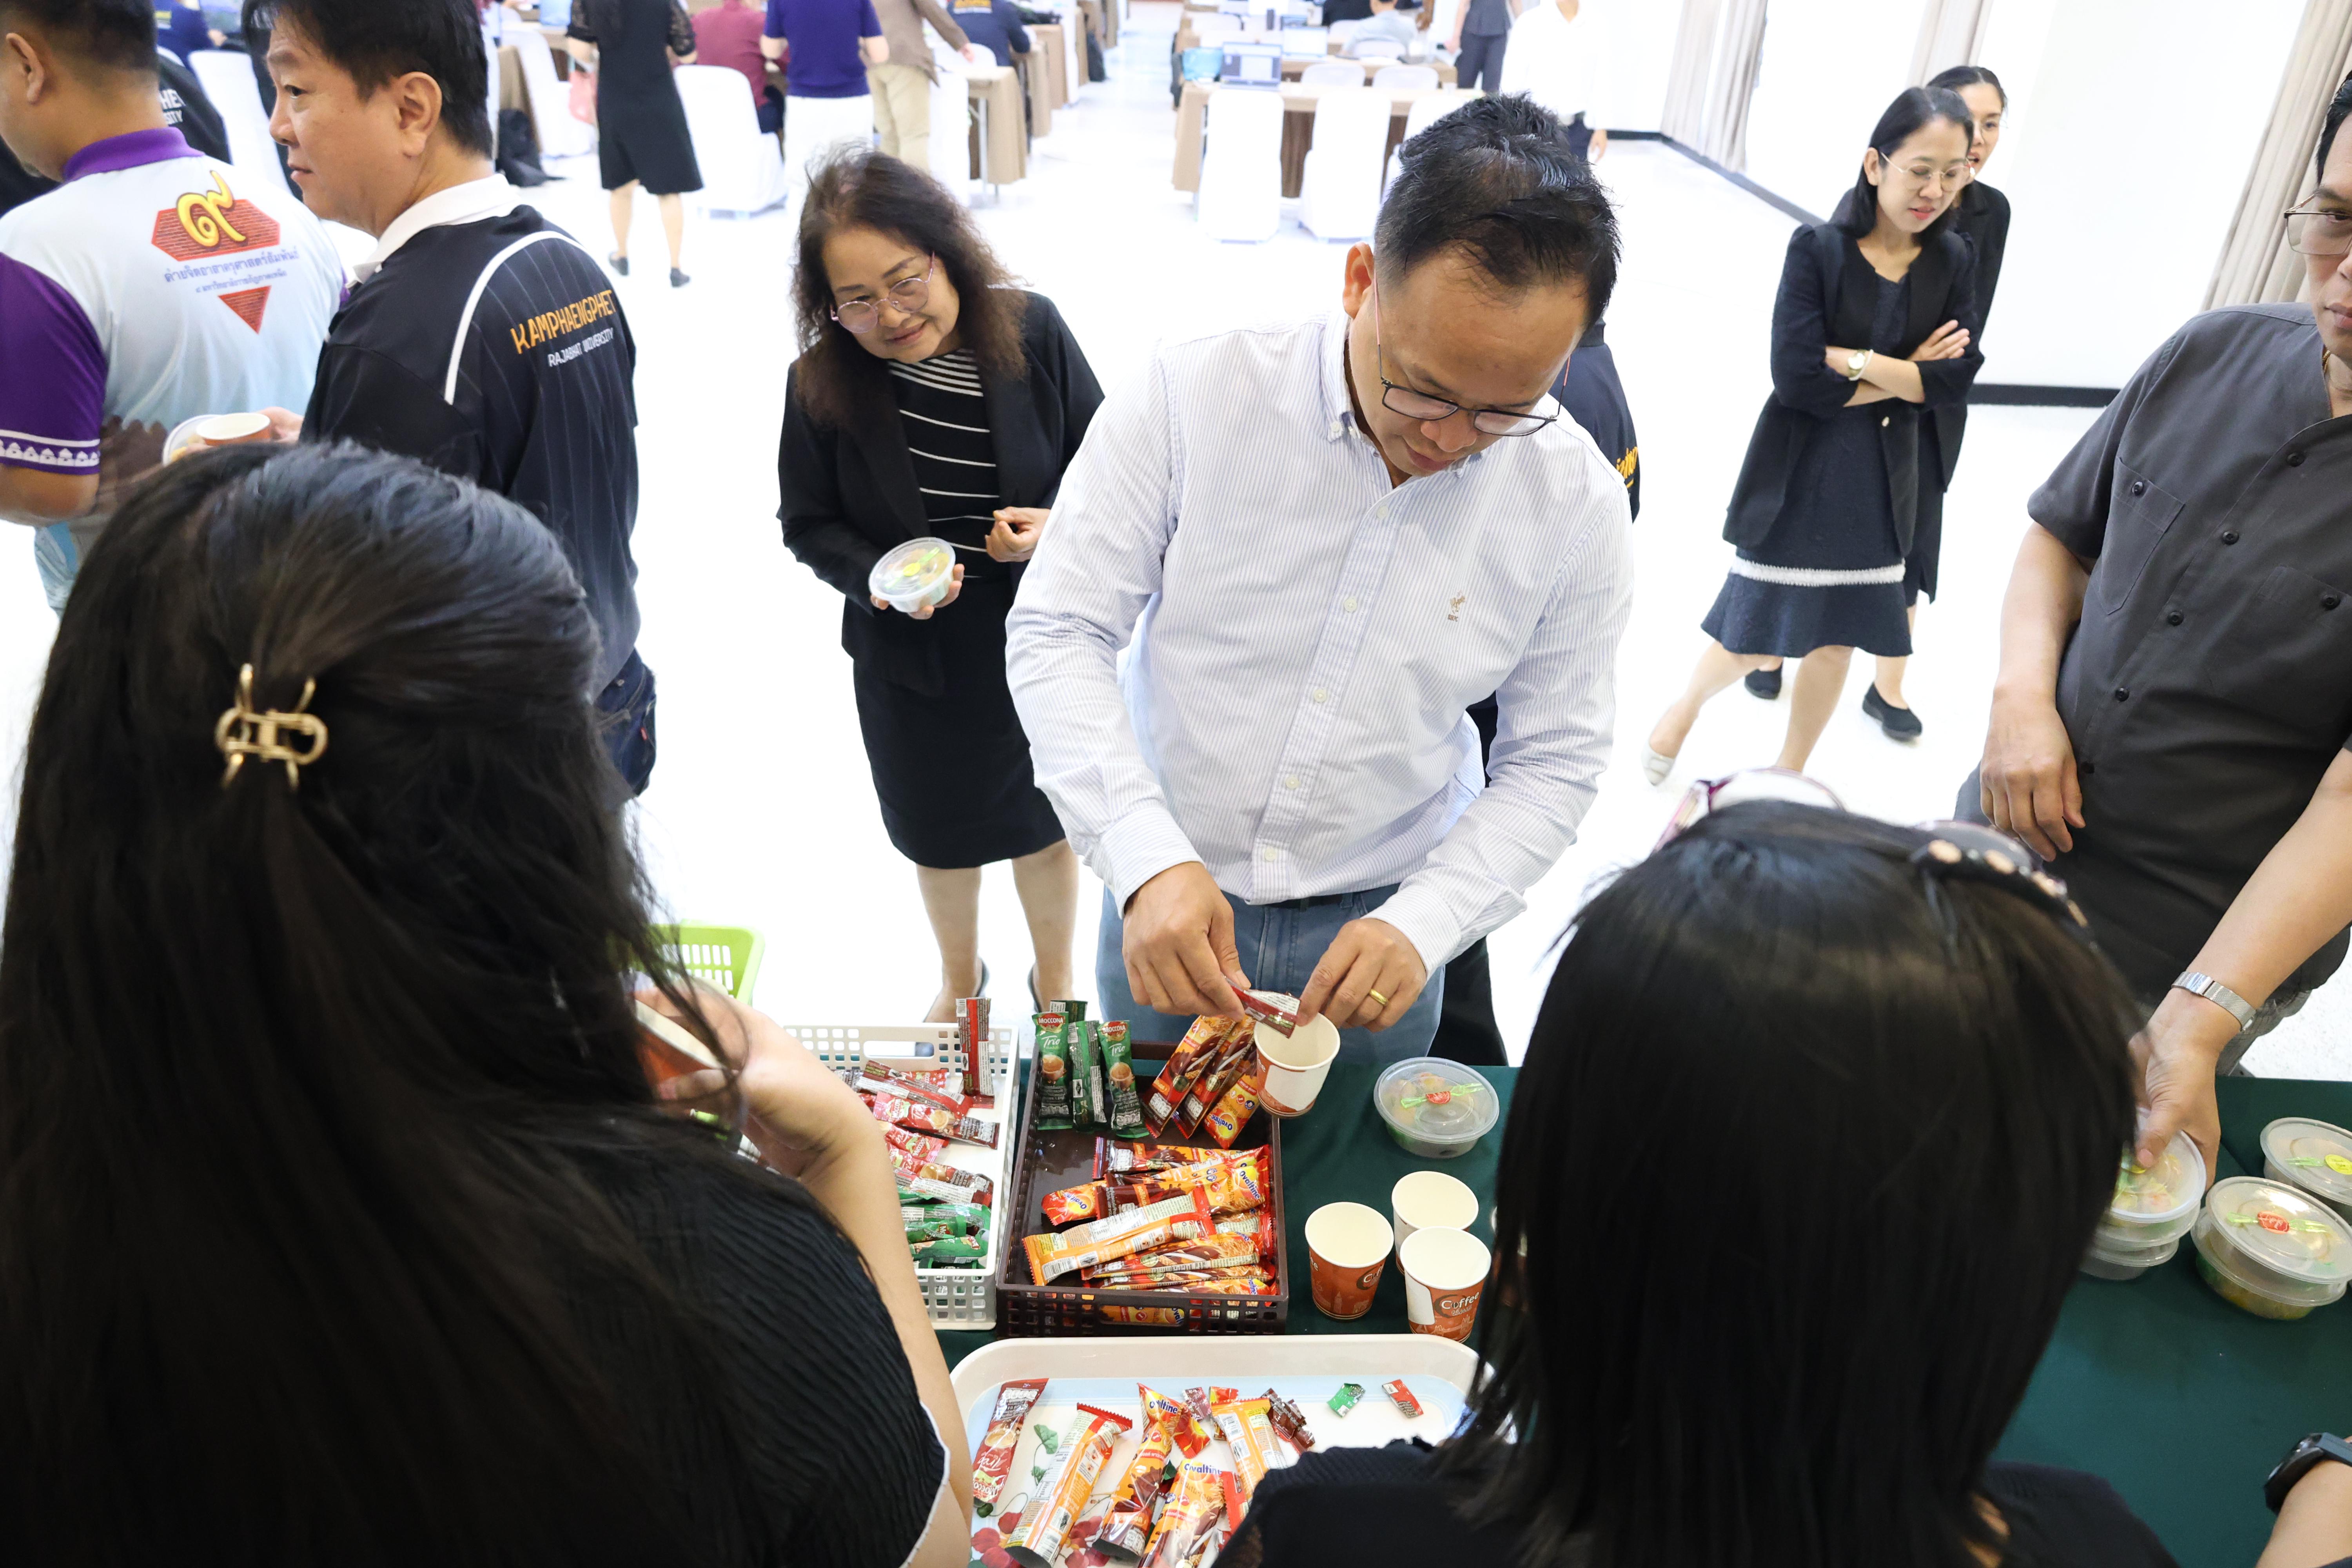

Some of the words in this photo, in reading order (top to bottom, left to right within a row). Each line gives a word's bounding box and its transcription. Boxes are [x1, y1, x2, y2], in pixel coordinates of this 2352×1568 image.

[510, 290, 616, 354] KAMPHAENGPHET
[548, 343, 583, 367] RAJABHAT
[582, 327, 614, 353] UNIVERSITY
[1102, 1024, 1126, 1033] MOCCONA
[1042, 1035, 1061, 1048] Trio
[1108, 1043, 1126, 1057] Trio
[1211, 1114, 1233, 1131] Ovaltine
[1240, 1171, 1260, 1199] Ovaltine
[1064, 1193, 1087, 1209] Ovaltne
[1363, 1265, 1384, 1283] Coff
[1248, 1279, 1258, 1295] valtine
[1441, 1292, 1479, 1309] Coffee
[974, 1482, 996, 1495] MOCCO
